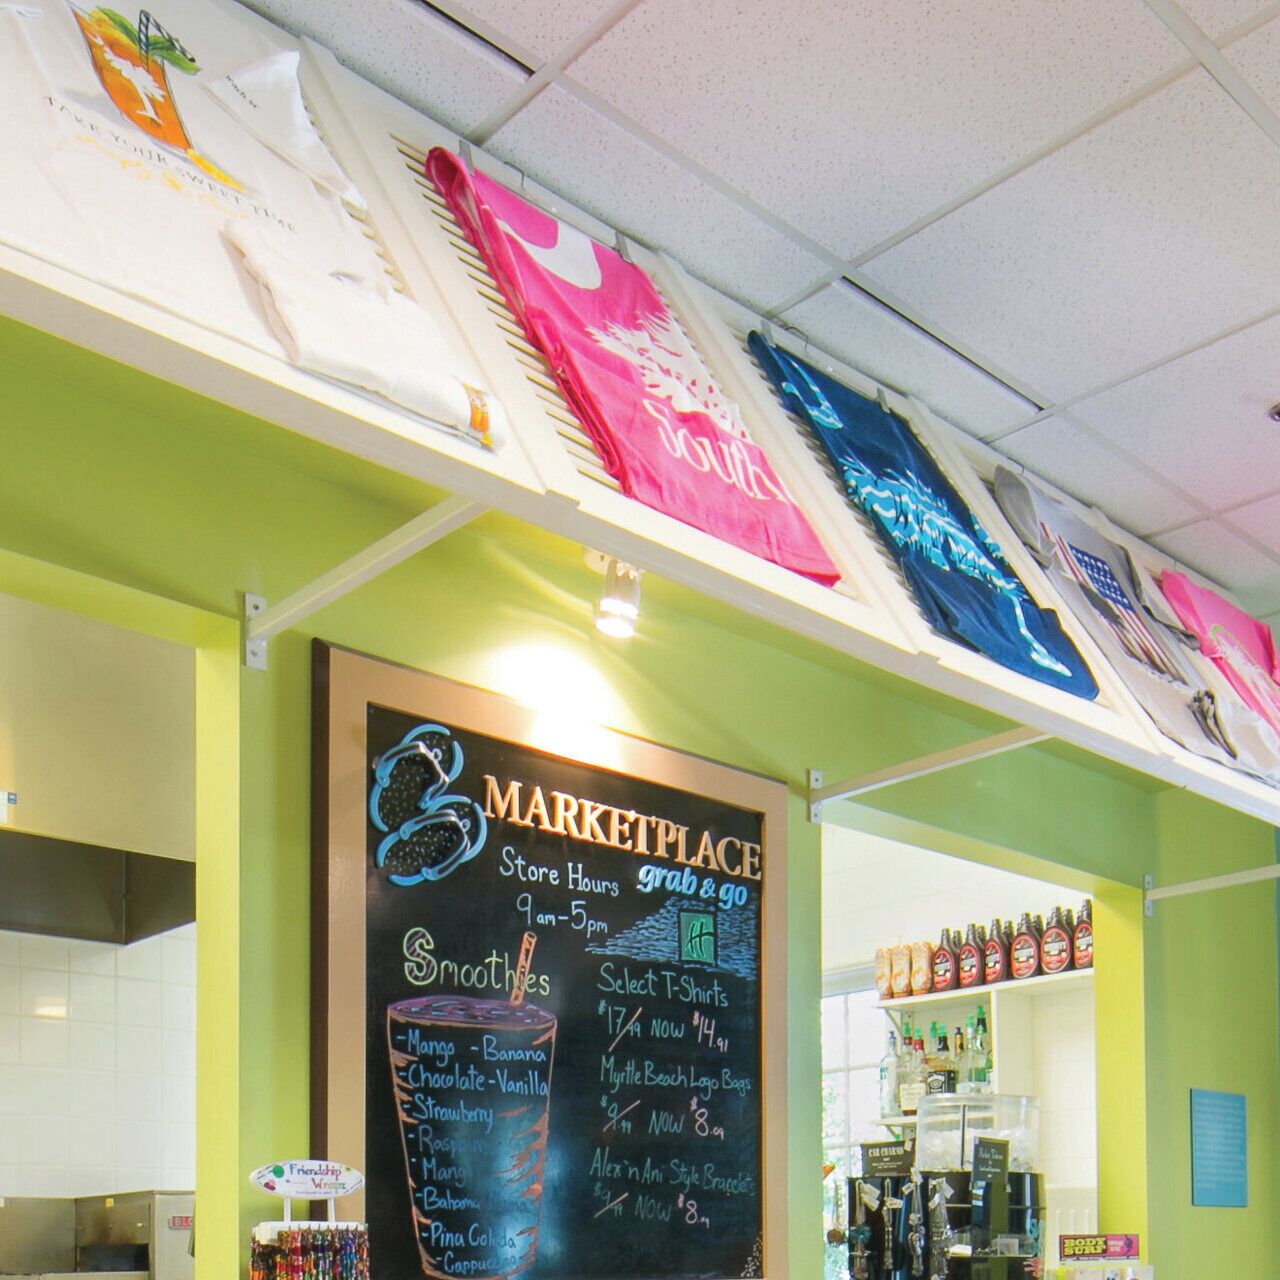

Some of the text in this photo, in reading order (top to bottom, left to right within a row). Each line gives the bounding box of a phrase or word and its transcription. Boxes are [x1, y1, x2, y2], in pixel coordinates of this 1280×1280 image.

[483, 774, 762, 880] MARKETPLACE
[499, 846, 619, 896] Store Hours
[637, 864, 748, 910] grab & go
[403, 927, 551, 996] Smoothies
[596, 962, 729, 1008] Select T-Shirts
[651, 1018, 686, 1038] NOW
[600, 1054, 752, 1101] Myrtle Beach Logo Bags
[648, 1109, 686, 1137] NOW
[289, 1163, 342, 1182] Friendship
[588, 1146, 622, 1179] Alex
[641, 1156, 664, 1185] Ani
[670, 1158, 701, 1194] Style
[634, 1194, 672, 1222] NOW
[1063, 1236, 1107, 1256] BODY SURF
